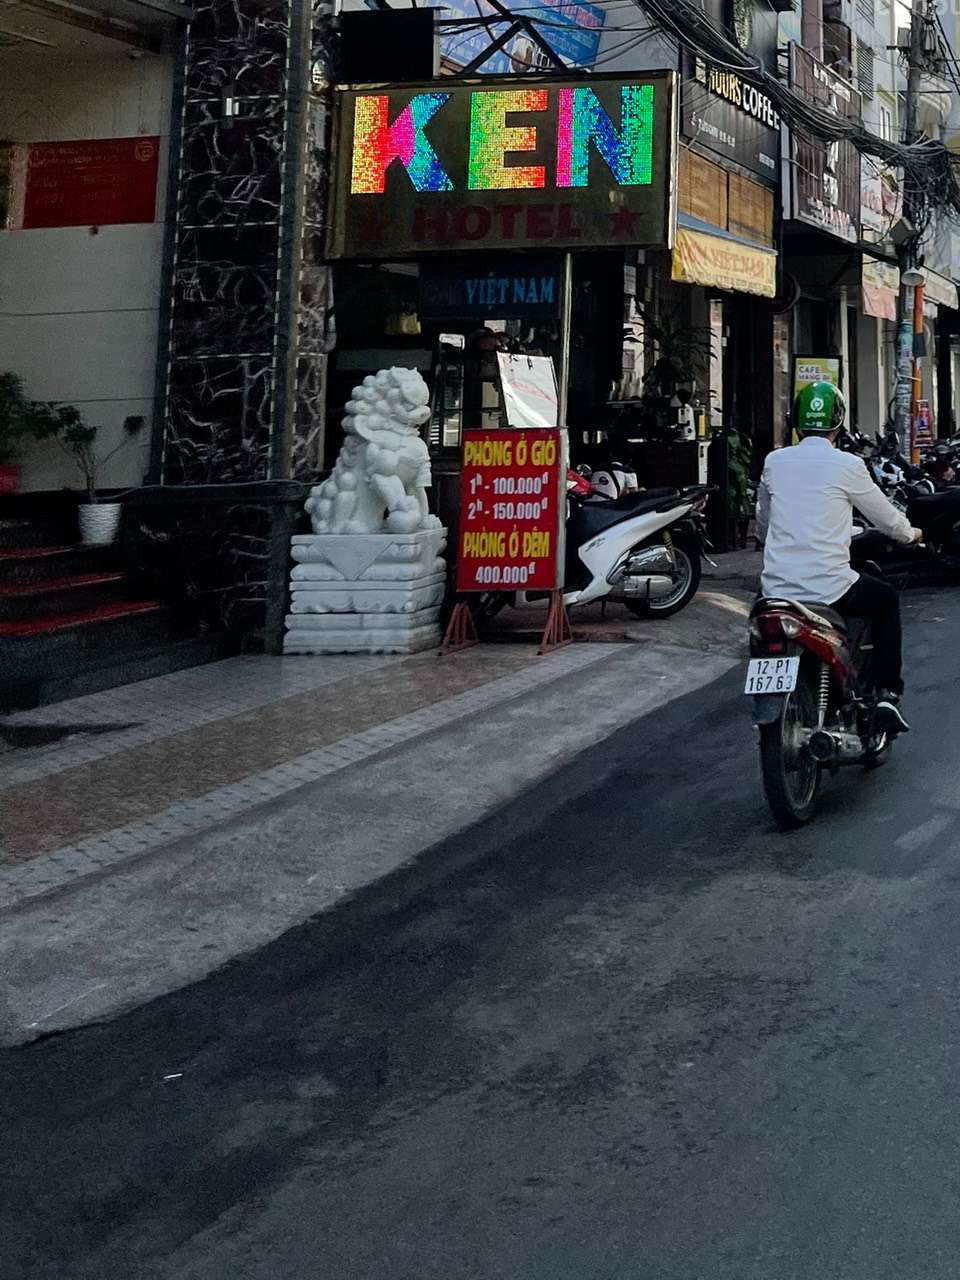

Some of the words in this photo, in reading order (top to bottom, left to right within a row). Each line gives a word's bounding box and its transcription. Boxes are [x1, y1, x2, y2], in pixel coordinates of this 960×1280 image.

[743, 82, 780, 131] COFFEE
[350, 84, 655, 195] KEN
[410, 202, 581, 243] HOTEL
[465, 271, 510, 311] VIỆT
[512, 276, 555, 304] NAM
[463, 435, 513, 467] PHÒNG
[463, 526, 505, 558] PHÒNG
[522, 525, 550, 558] ĐÊM
